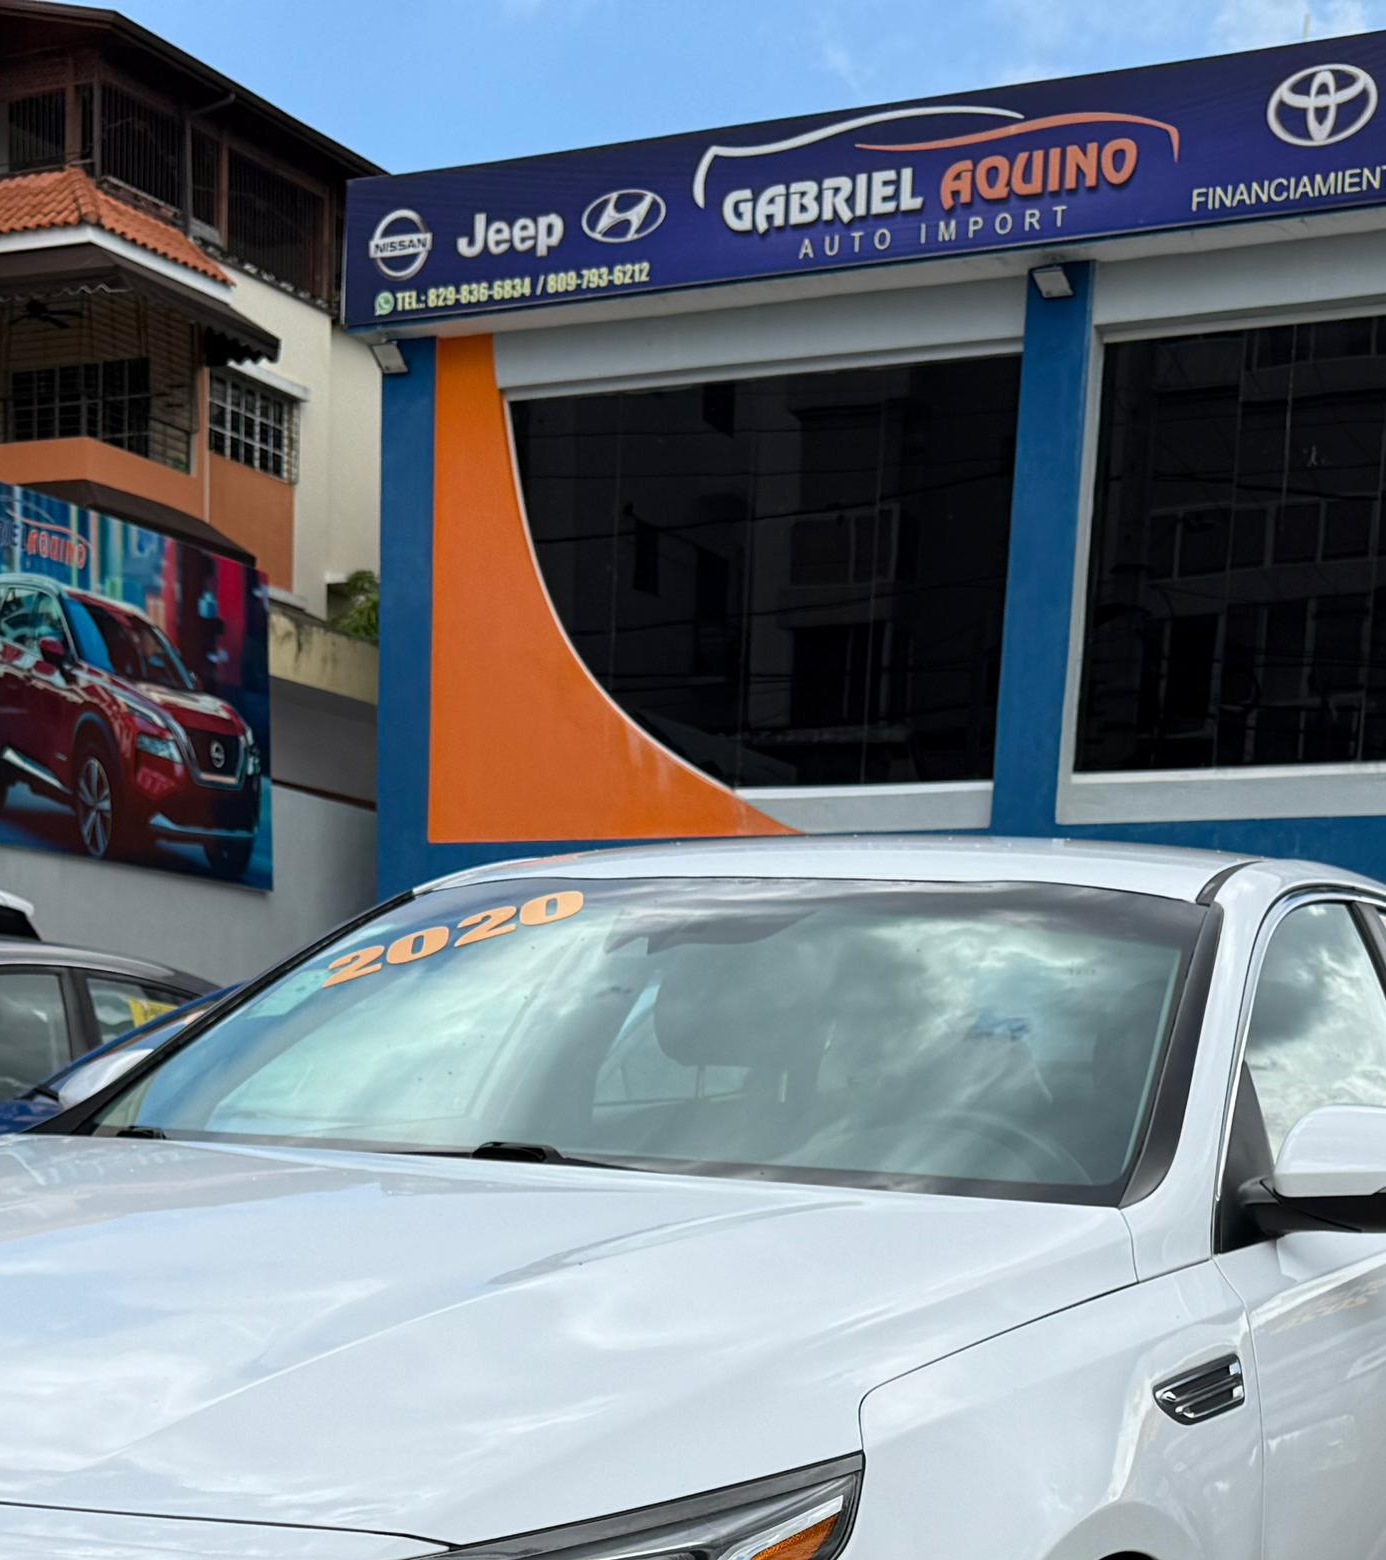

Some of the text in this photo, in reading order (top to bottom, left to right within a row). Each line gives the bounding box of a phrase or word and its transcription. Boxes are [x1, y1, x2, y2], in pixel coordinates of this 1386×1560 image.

[723, 137, 1139, 234] GABRIEL AQUINO
[373, 237, 428, 255] NISSAN
[457, 212, 564, 257] Jeep
[799, 205, 1068, 260] AUTO IMPORT
[427, 276, 532, 308] 829-836-6834
[546, 261, 651, 294] 809-793-6212
[322, 890, 584, 988] 2020
